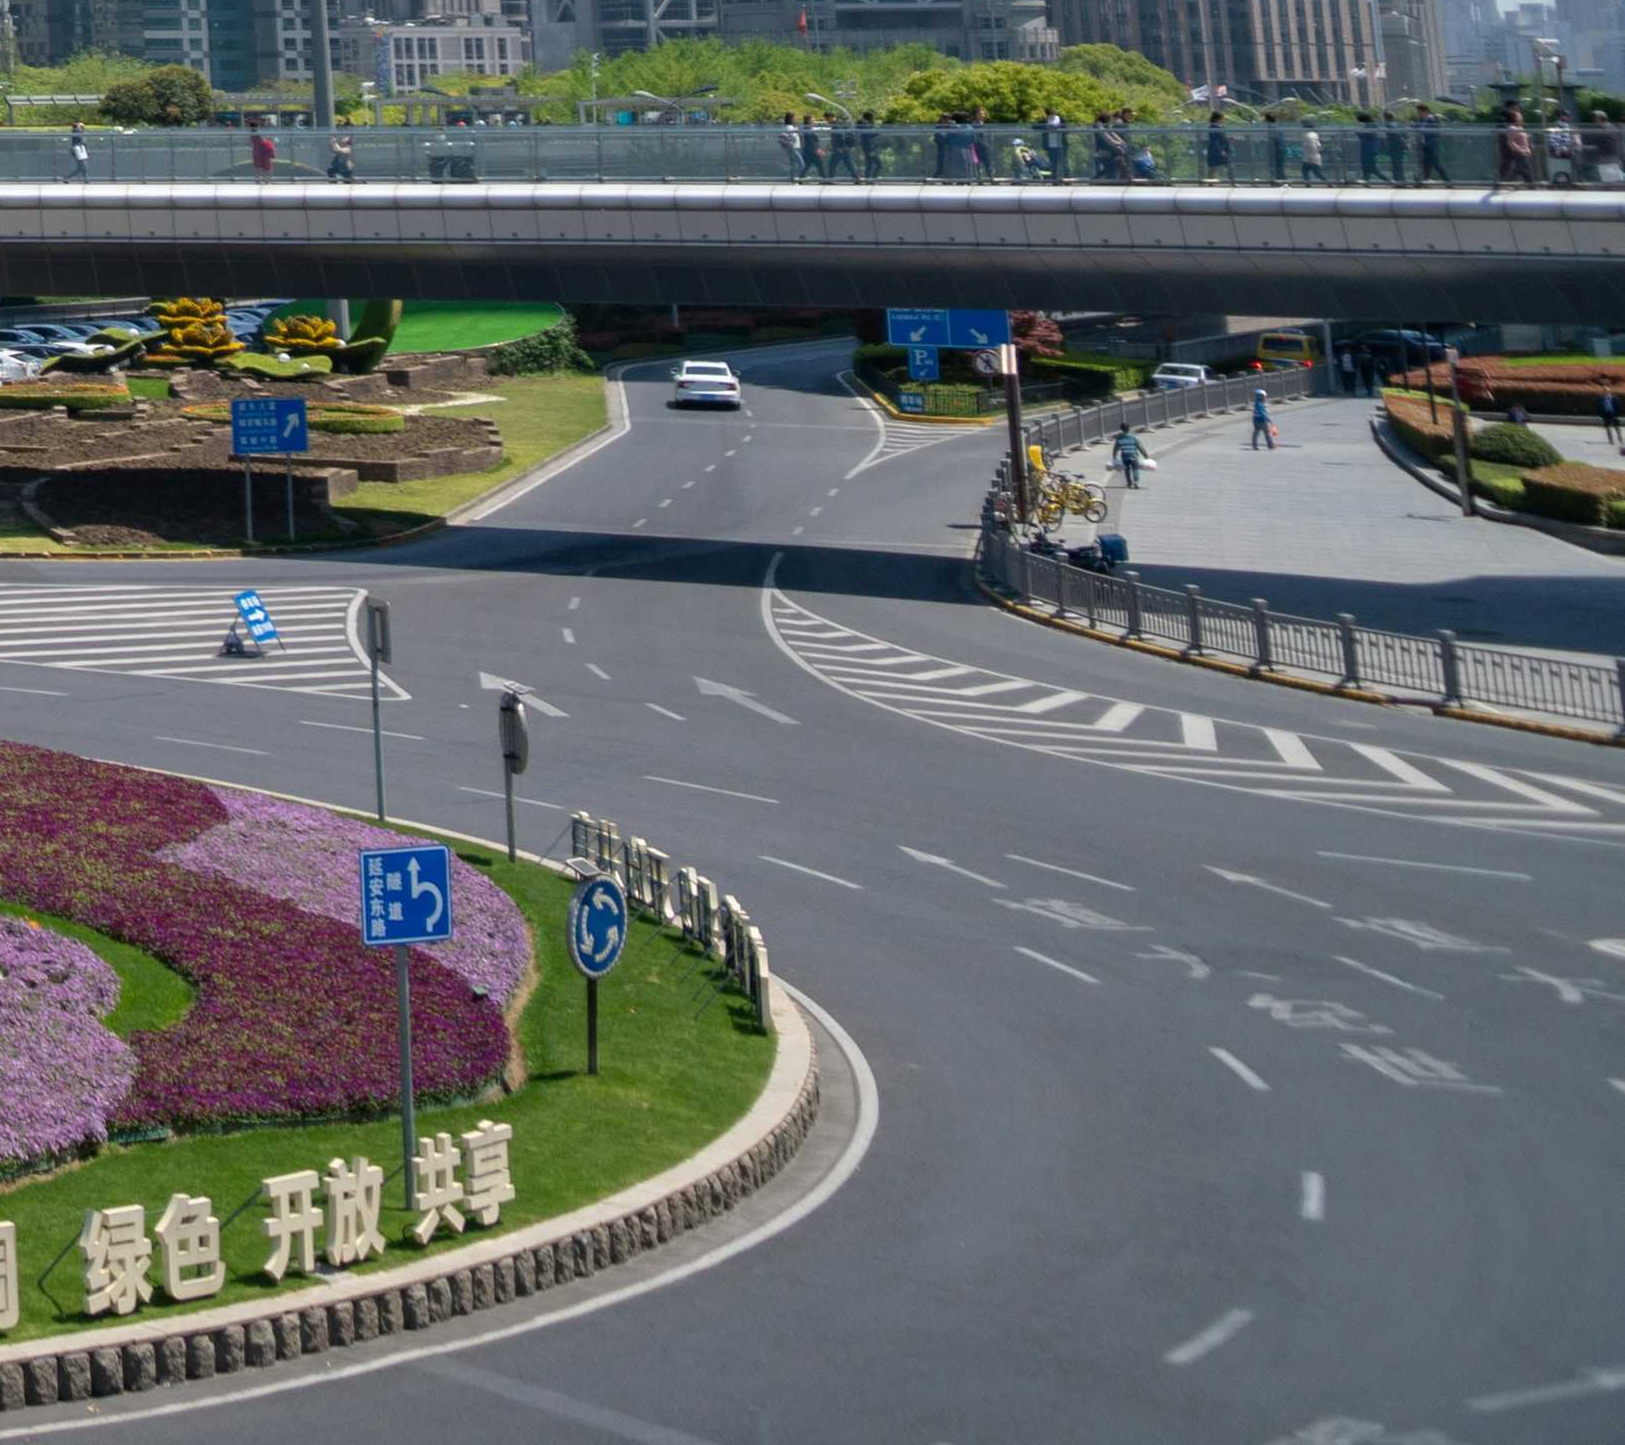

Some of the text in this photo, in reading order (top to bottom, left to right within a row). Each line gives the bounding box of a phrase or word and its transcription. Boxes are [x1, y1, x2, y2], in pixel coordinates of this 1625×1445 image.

[367, 856, 387, 938] 延安东路
[385, 870, 404, 921] 隧道
[77, 1191, 228, 1317] 绿色
[258, 1154, 387, 1283] 开放
[409, 1117, 519, 1247] 共享
